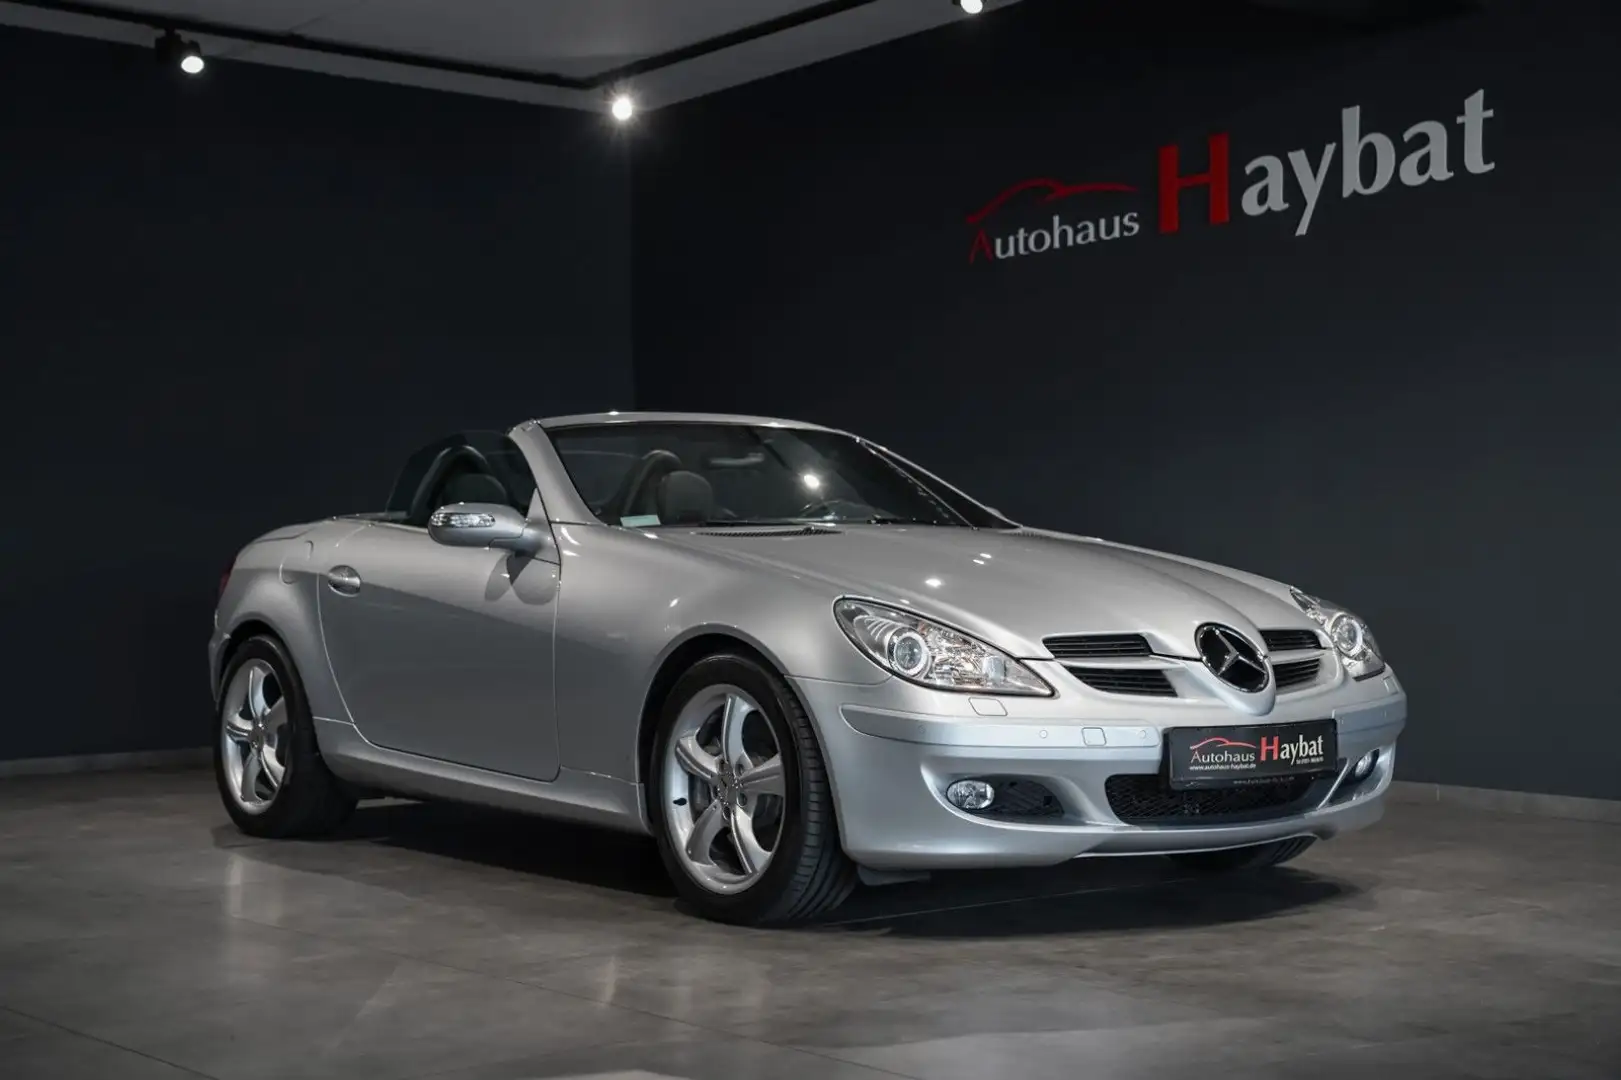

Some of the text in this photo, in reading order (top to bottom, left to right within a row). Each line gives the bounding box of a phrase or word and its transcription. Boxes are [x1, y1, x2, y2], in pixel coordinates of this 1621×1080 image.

[969, 88, 1496, 263] Autohaus Haybat
[1190, 734, 1324, 766] Autohaus Haybat
